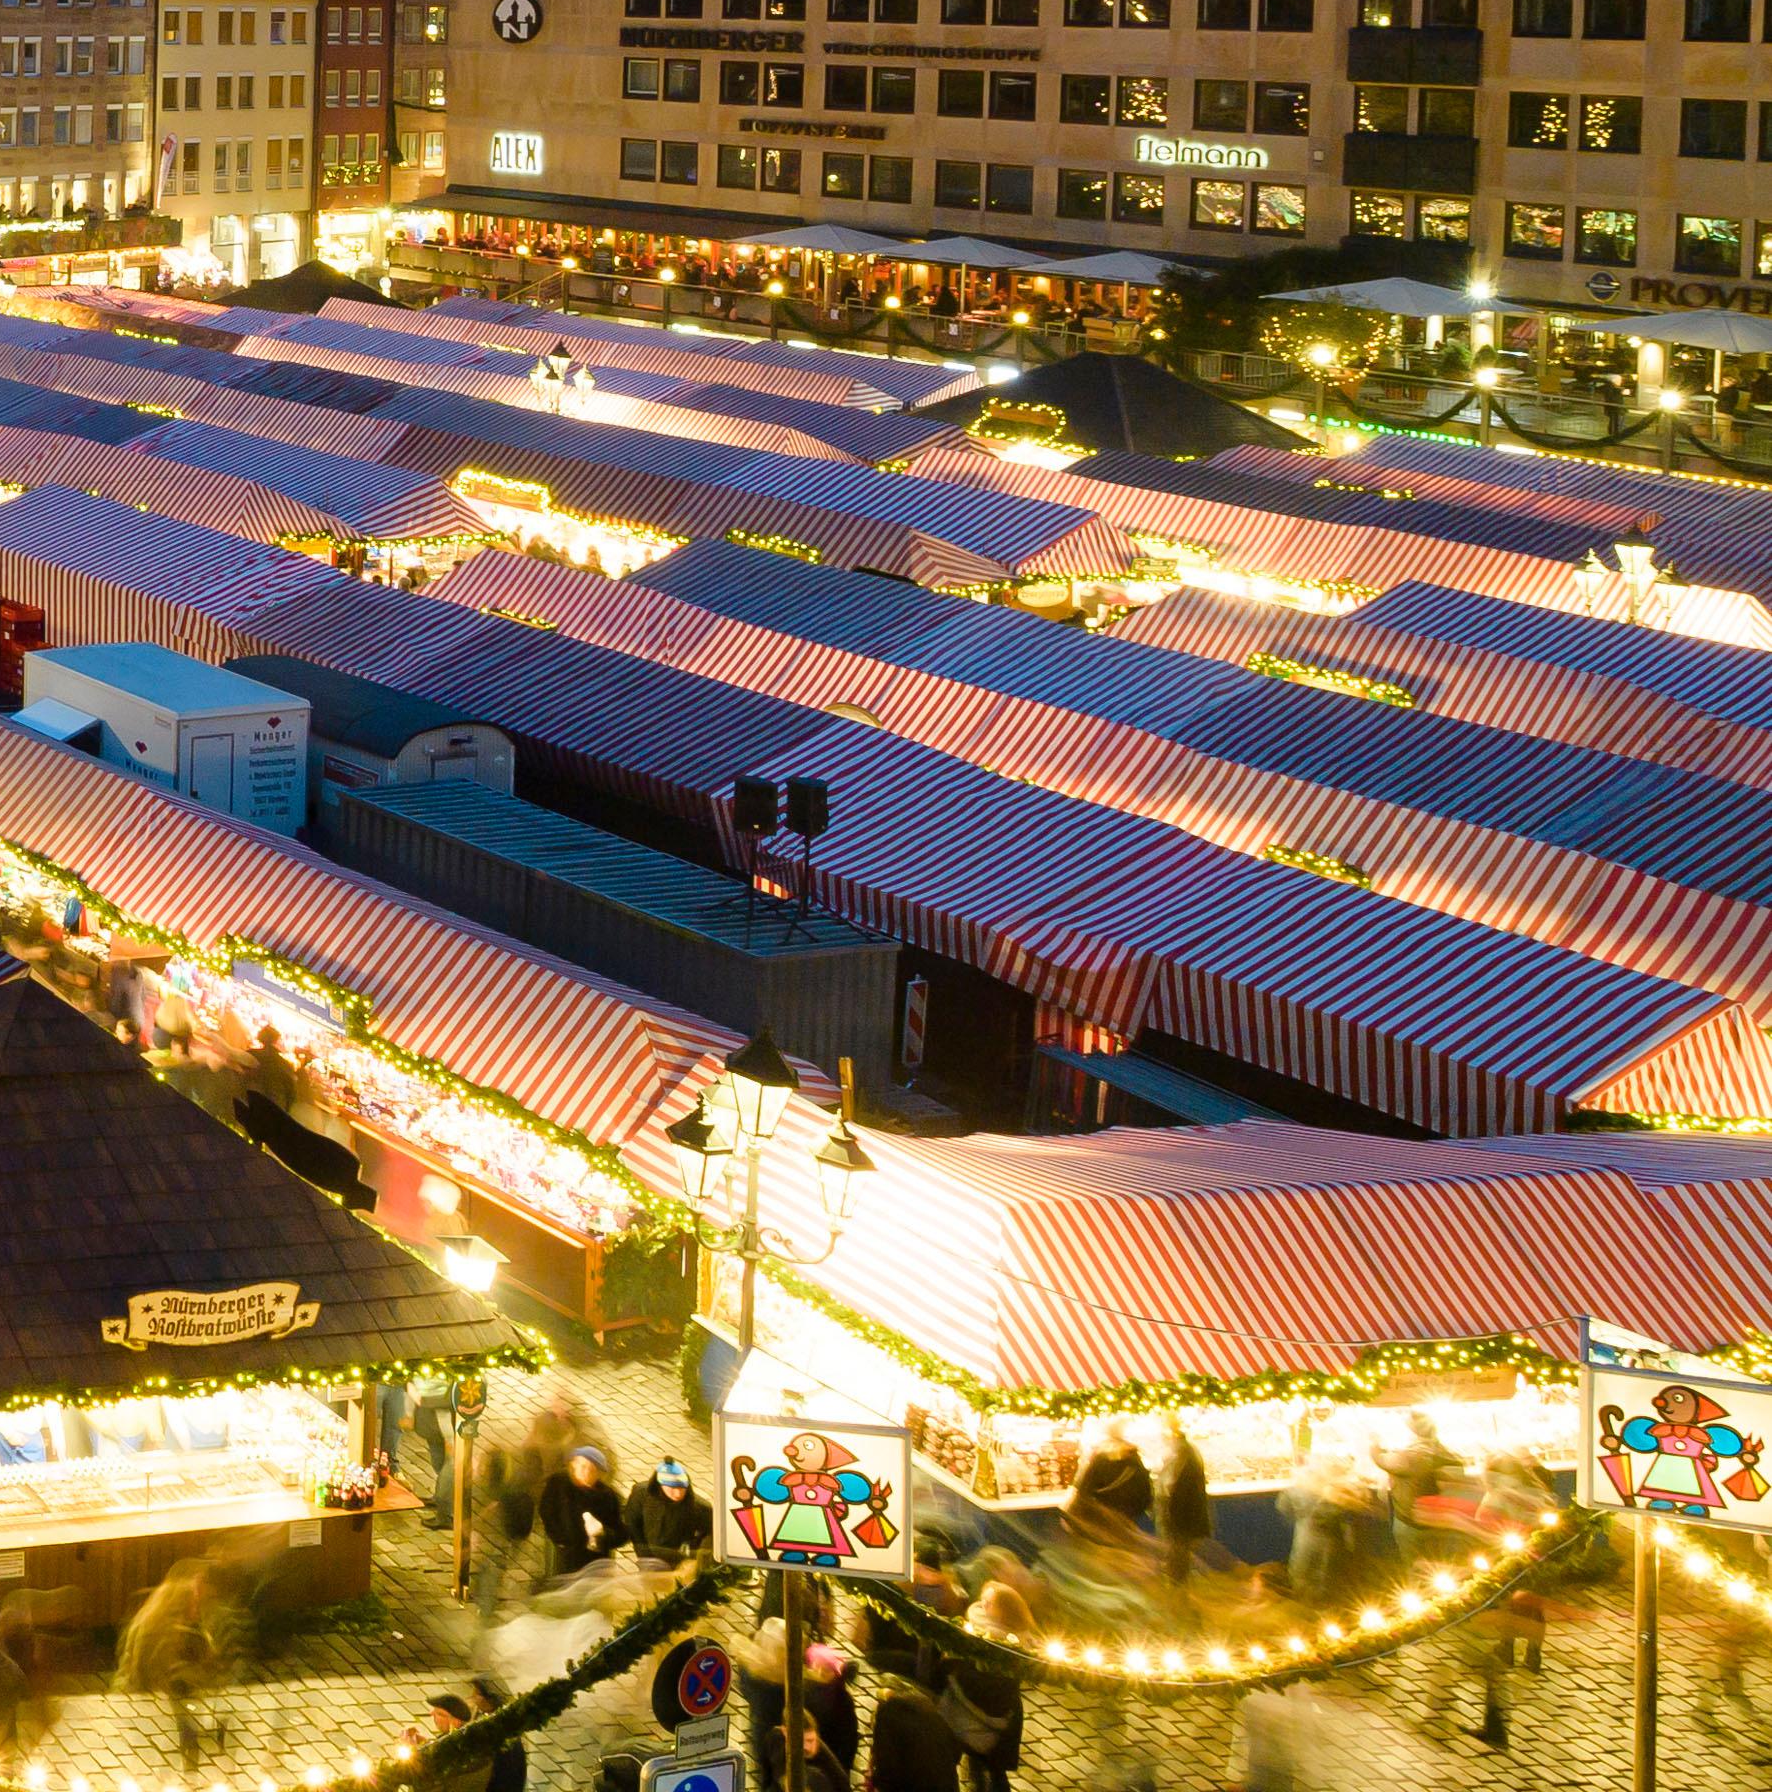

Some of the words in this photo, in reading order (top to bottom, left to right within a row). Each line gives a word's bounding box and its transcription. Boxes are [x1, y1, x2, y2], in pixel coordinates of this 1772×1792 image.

[620, 27, 805, 54] NÜRNBERGER
[492, 136, 537, 171] ALEX
[160, 1293, 266, 1317] Nürnberger
